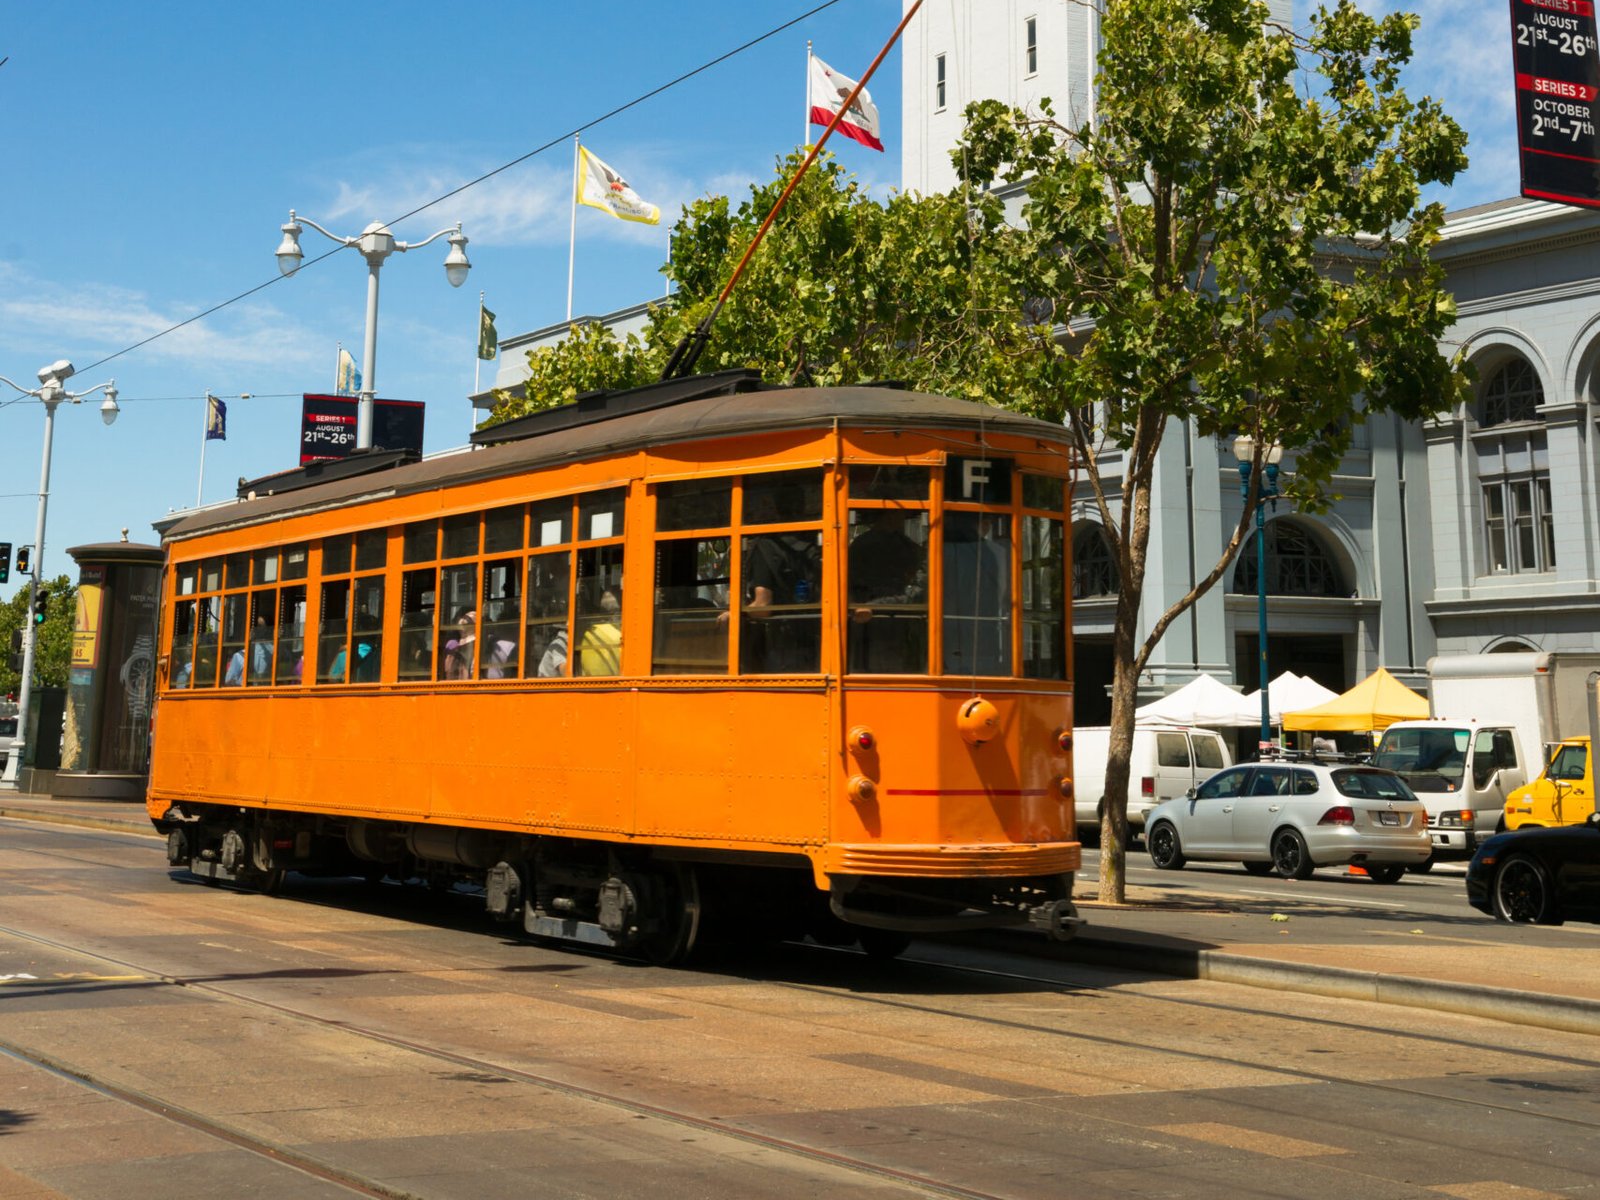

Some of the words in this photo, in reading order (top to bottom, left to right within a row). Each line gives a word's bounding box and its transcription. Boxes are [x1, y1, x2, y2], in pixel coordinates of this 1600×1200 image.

[1572, 1, 1577, 12] 1
[1533, 12, 1578, 31] AUGUST
[1535, 79, 1576, 97] SERIES
[1579, 86, 1586, 98] 2
[1534, 99, 1590, 118] OCTOBER
[315, 415, 340, 423] SERIES
[963, 460, 992, 498] F
